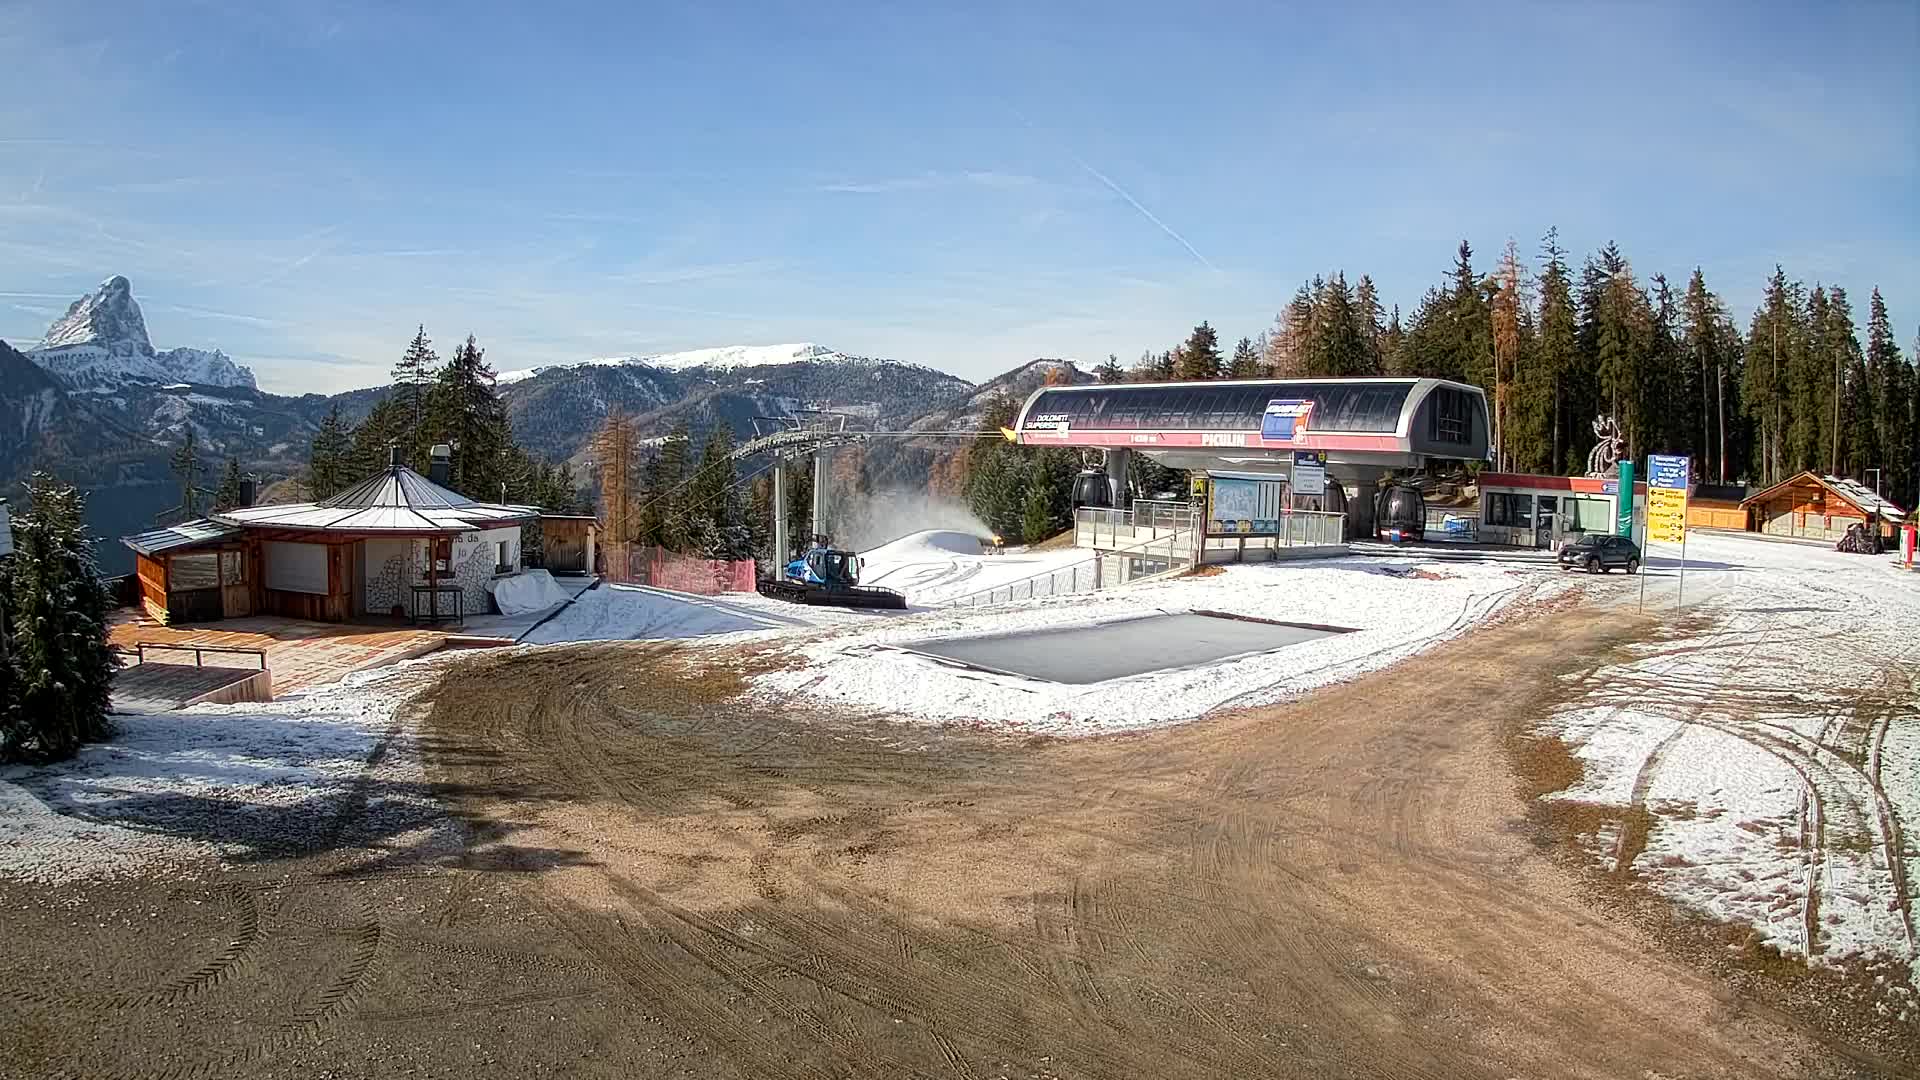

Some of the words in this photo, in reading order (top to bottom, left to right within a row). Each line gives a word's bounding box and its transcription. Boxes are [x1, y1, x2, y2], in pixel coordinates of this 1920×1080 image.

[1037, 414, 1069, 422] DOLOMITI
[1025, 421, 1059, 429] SUPERSKI
[1201, 433, 1245, 447] PICULIN
[467, 533, 479, 543] da
